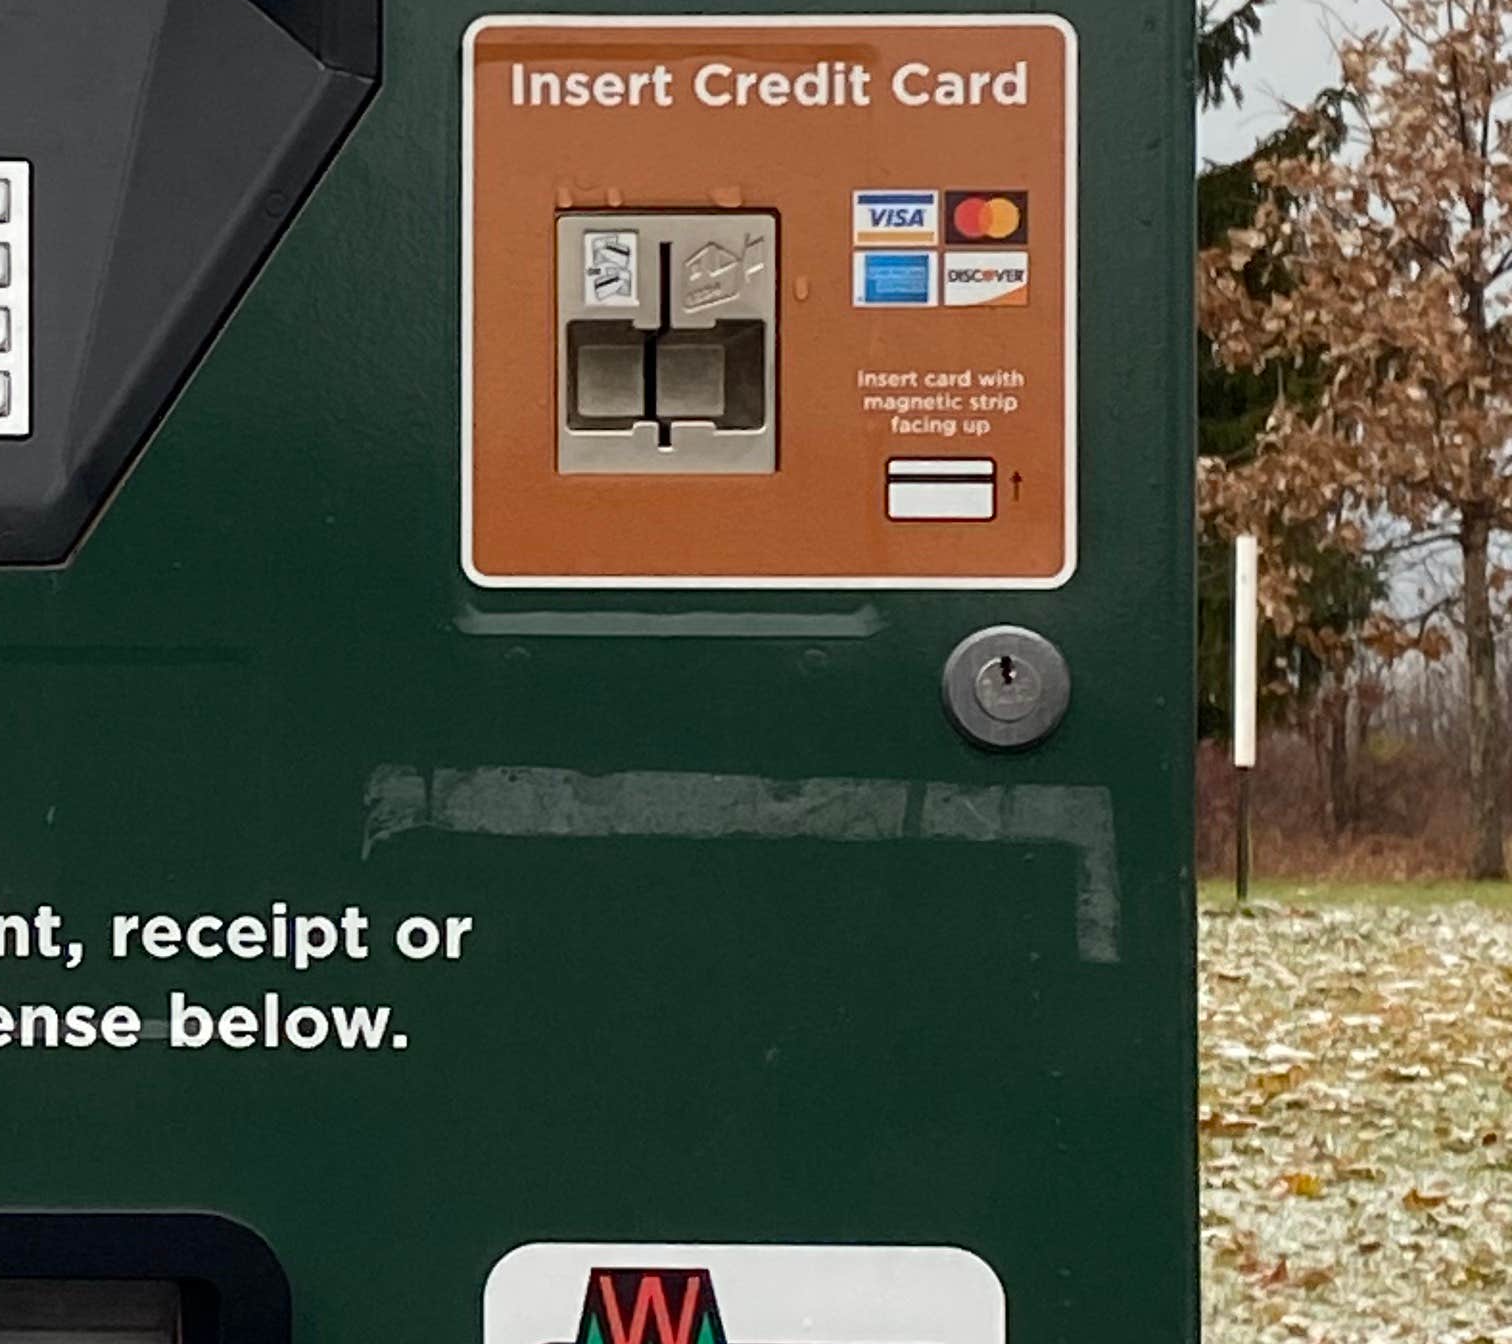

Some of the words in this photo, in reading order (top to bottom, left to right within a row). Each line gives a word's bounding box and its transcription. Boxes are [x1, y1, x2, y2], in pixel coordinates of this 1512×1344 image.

[512, 63, 673, 107] Insert
[694, 61, 871, 106] Credit
[892, 61, 1027, 106] Card
[870, 209, 925, 227] VISA
[948, 269, 1024, 282] DISCOVER
[857, 369, 918, 388] Insert
[924, 369, 972, 388] card
[977, 369, 1025, 388] with
[863, 392, 963, 414] magnetic
[969, 393, 1018, 414] strip
[890, 415, 957, 437] facing
[962, 419, 991, 437] up
[113, 902, 369, 970] receipt
[396, 916, 473, 959] or
[170, 994, 409, 1049] below.
